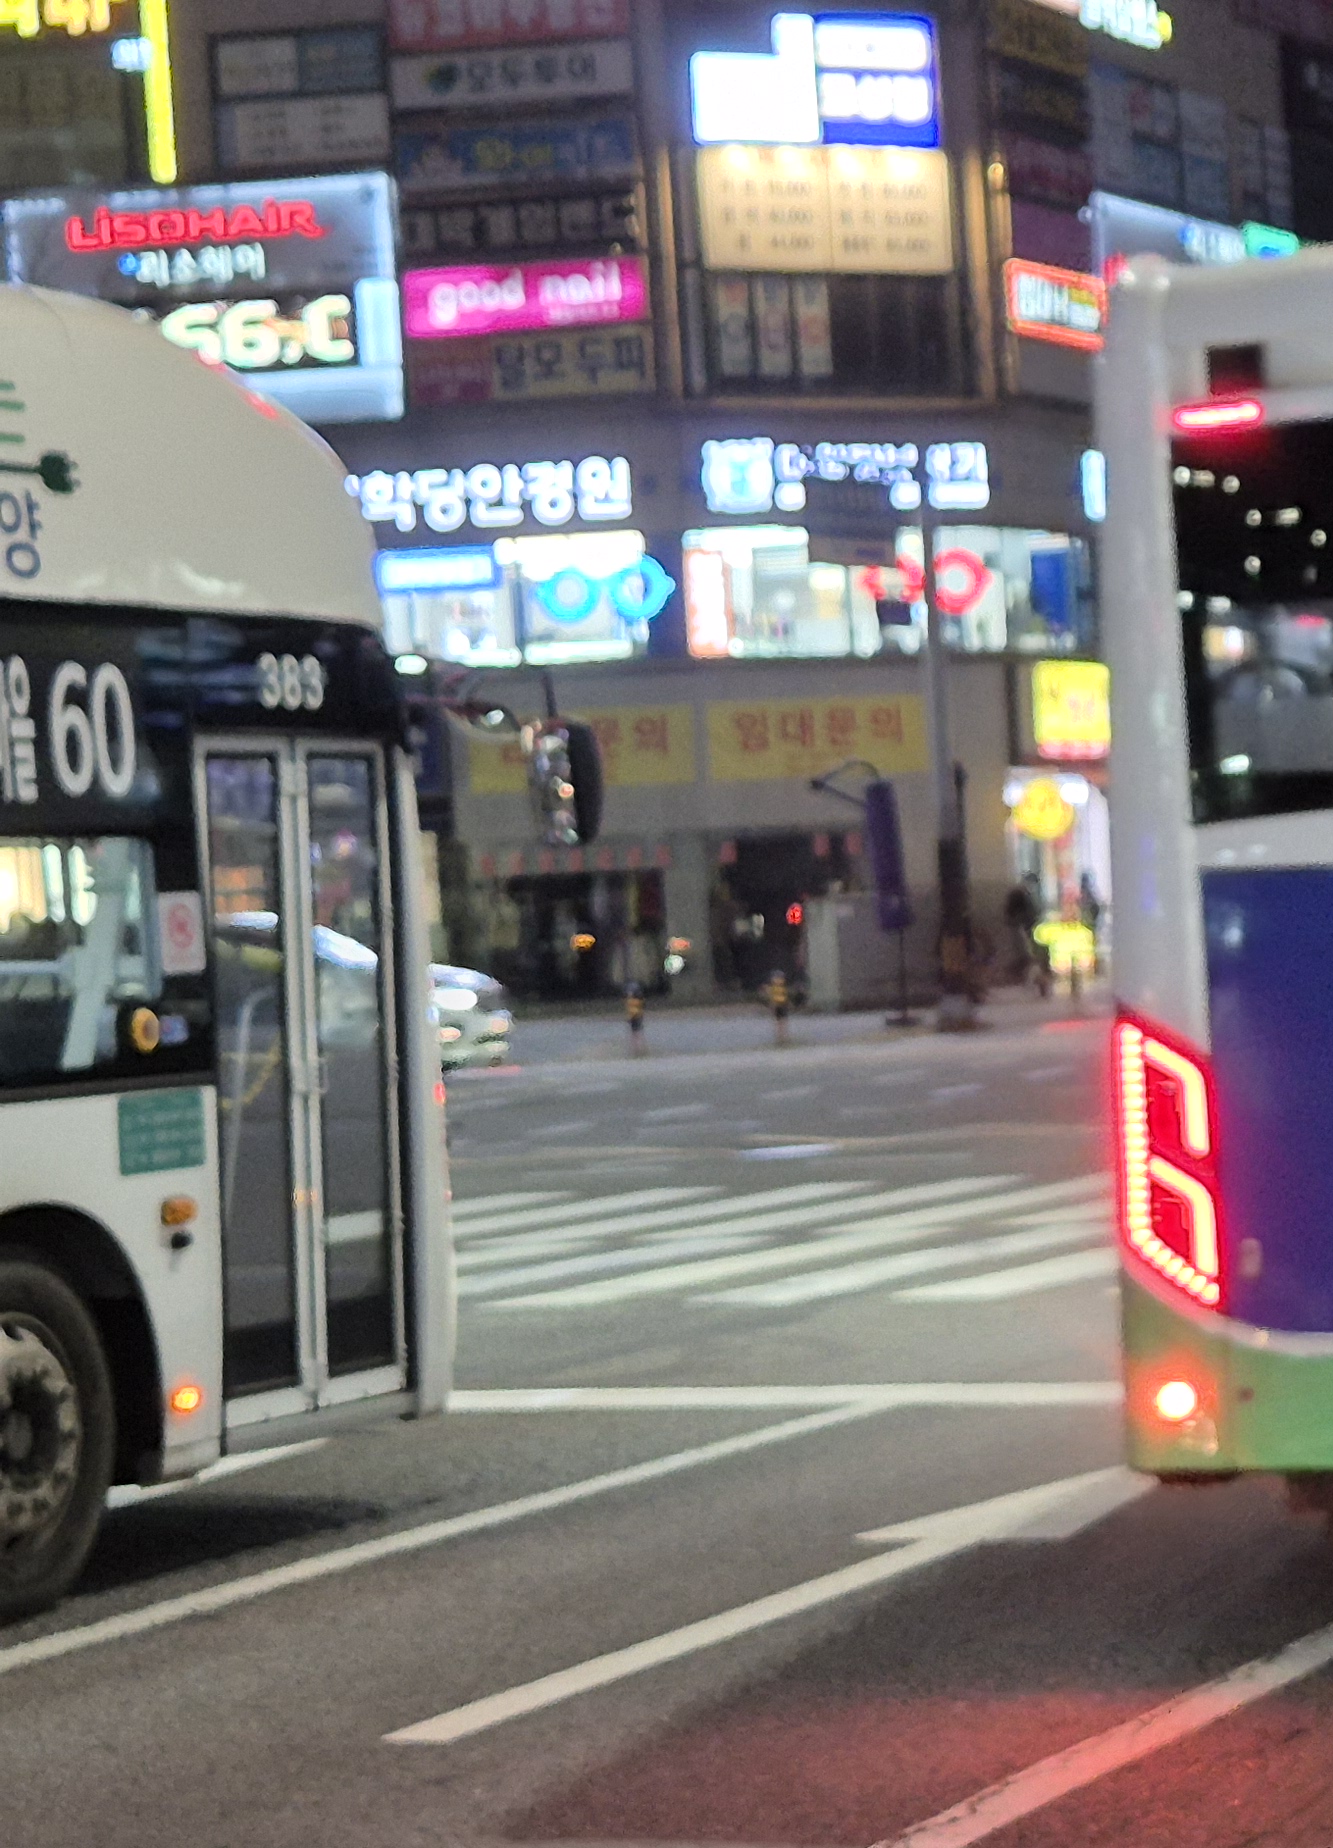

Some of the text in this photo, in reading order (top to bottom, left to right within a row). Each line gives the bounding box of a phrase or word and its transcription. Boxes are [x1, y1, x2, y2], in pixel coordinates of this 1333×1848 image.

[426, 267, 526, 329] good
[538, 260, 623, 305] nail
[345, 455, 633, 532] 학당안경원
[0, 652, 38, 805] 을
[49, 659, 138, 798] 60
[734, 705, 904, 752] 임대문의
